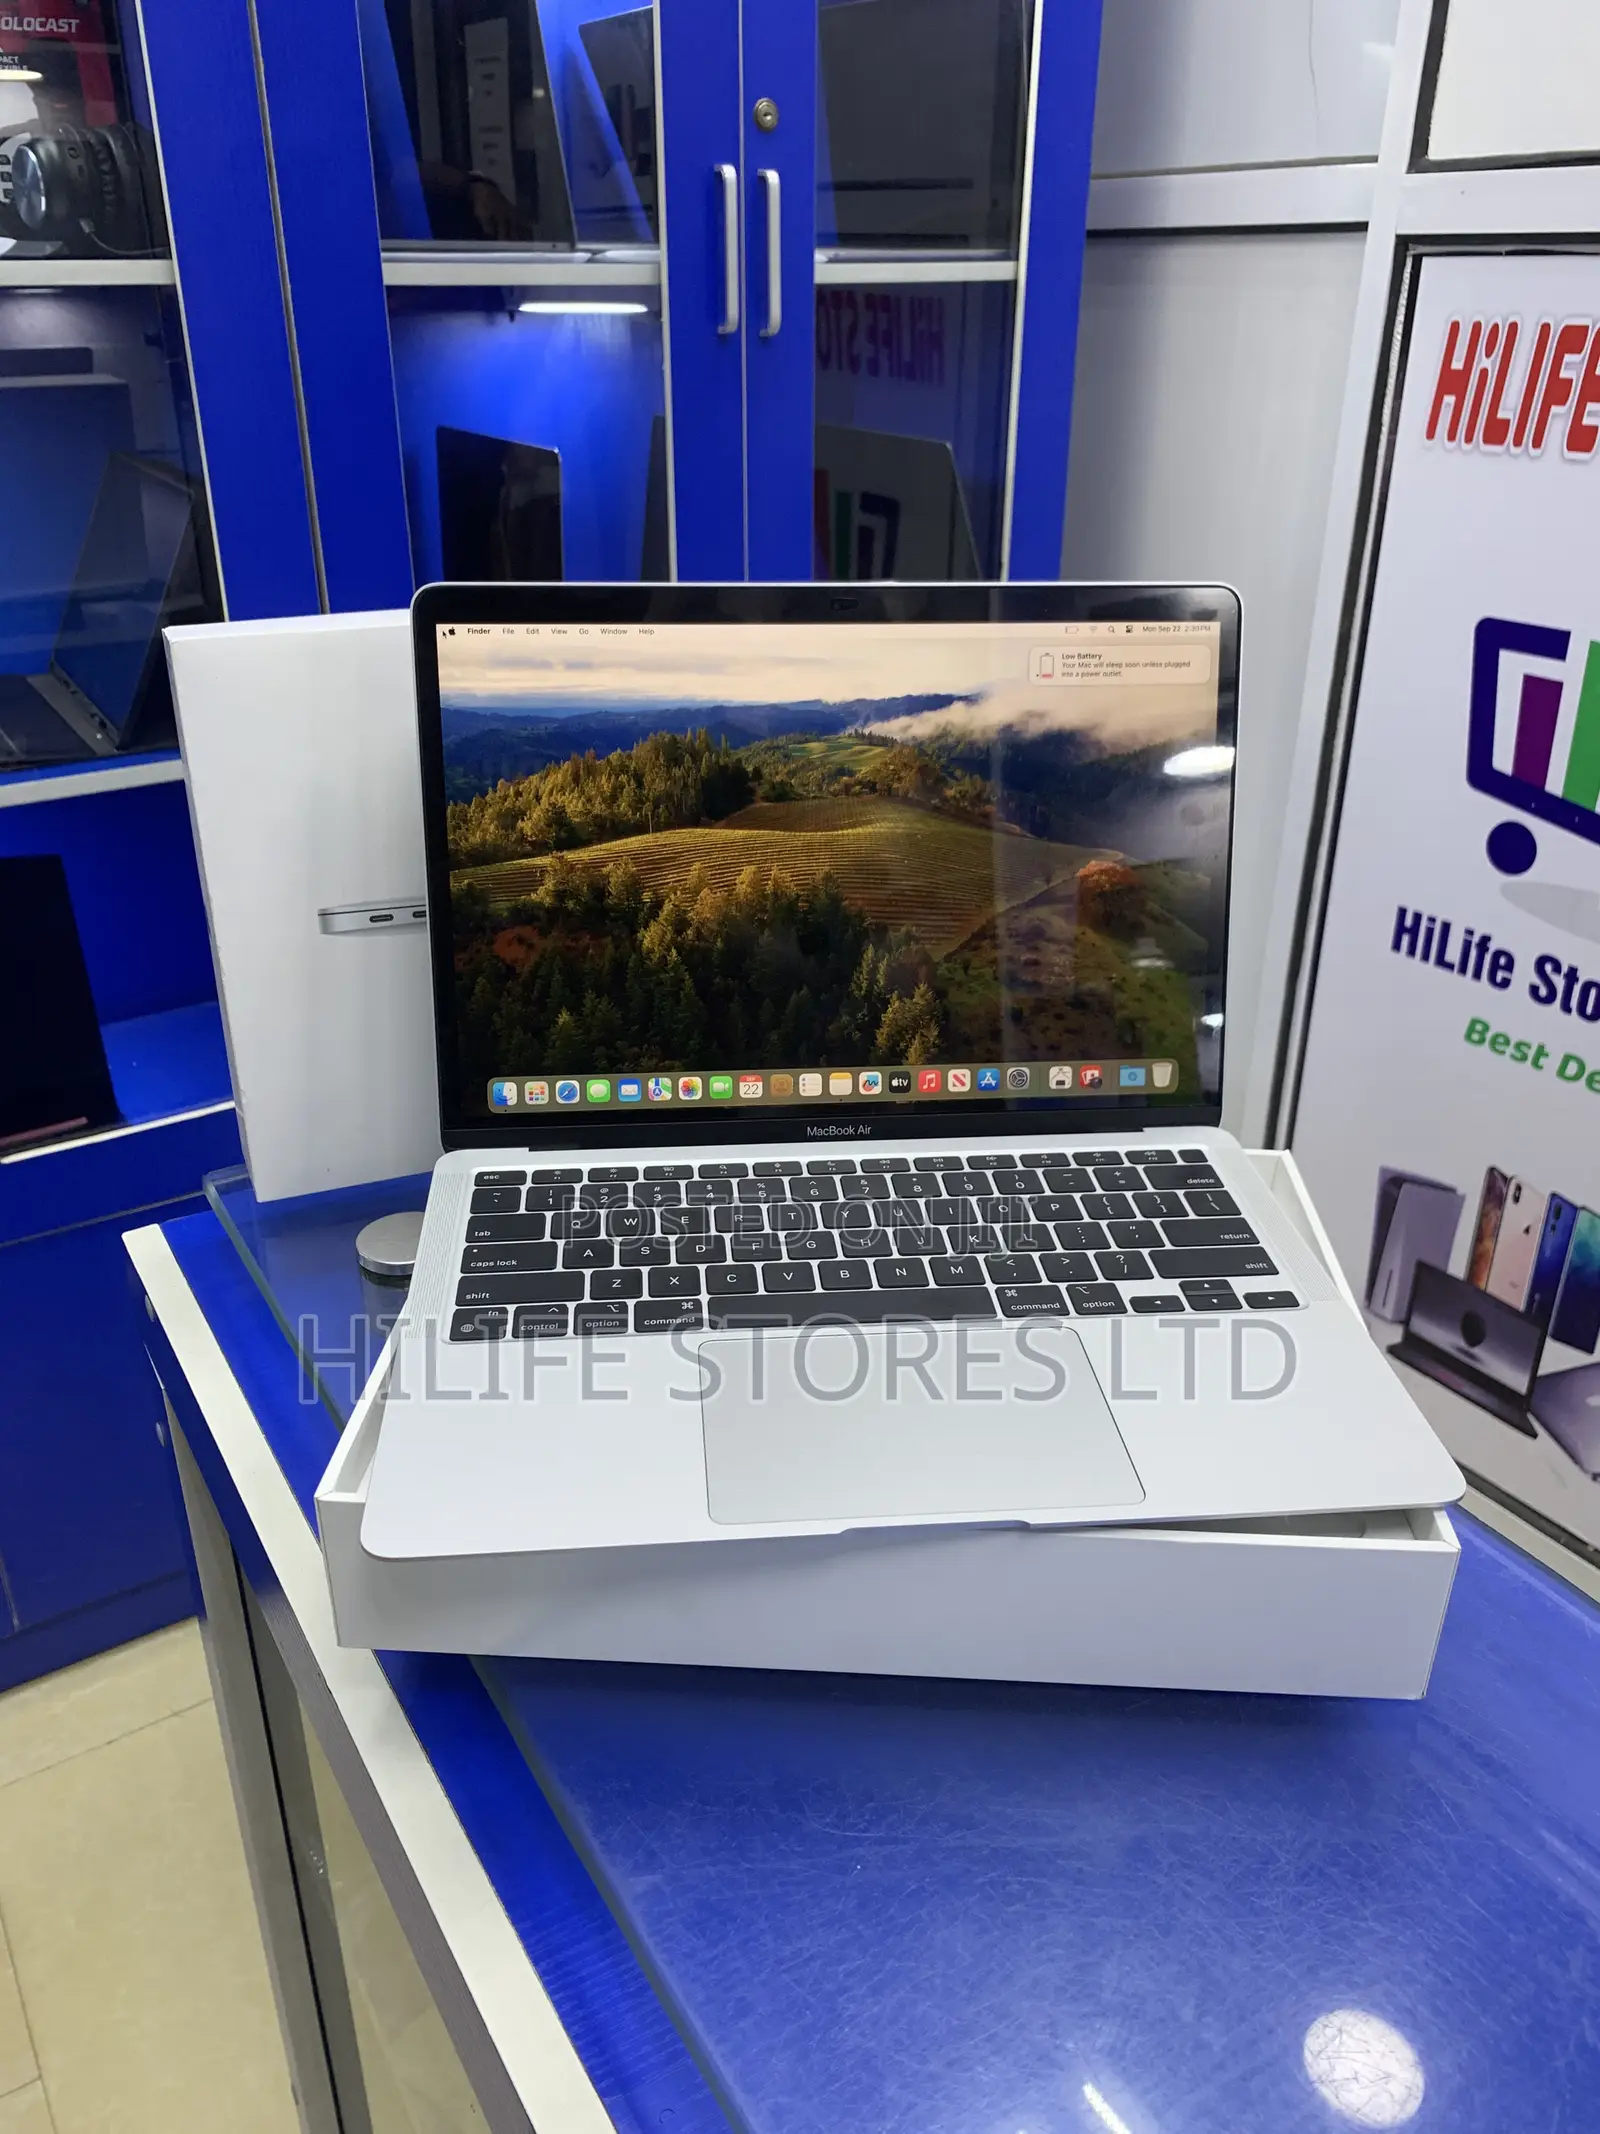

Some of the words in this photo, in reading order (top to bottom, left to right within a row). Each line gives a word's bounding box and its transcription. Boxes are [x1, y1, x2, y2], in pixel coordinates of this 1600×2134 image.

[1106, 661, 1123, 669] sleep
[1164, 661, 1190, 669] plugged
[1390, 905, 1516, 990] HiLife
[1463, 1016, 1551, 1071] Best
[743, 1084, 759, 1095] 22
[807, 1125, 855, 1136] MacBook
[857, 1124, 871, 1135] Air
[999, 1205, 1008, 1213] O
[571, 1220, 581, 1229] Q
[860, 1239, 871, 1247] H
[917, 1237, 924, 1245] J
[968, 1235, 980, 1244] K
[641, 1247, 650, 1255] S
[840, 1270, 850, 1278] B
[896, 1268, 907, 1276] N
[950, 1266, 963, 1274] M
[670, 1276, 679, 1285] X
[727, 1274, 737, 1282] C
[612, 1279, 621, 1287] Z
[586, 1320, 619, 1329] option
[644, 1317, 695, 1325] command
[521, 1323, 558, 1331] control
